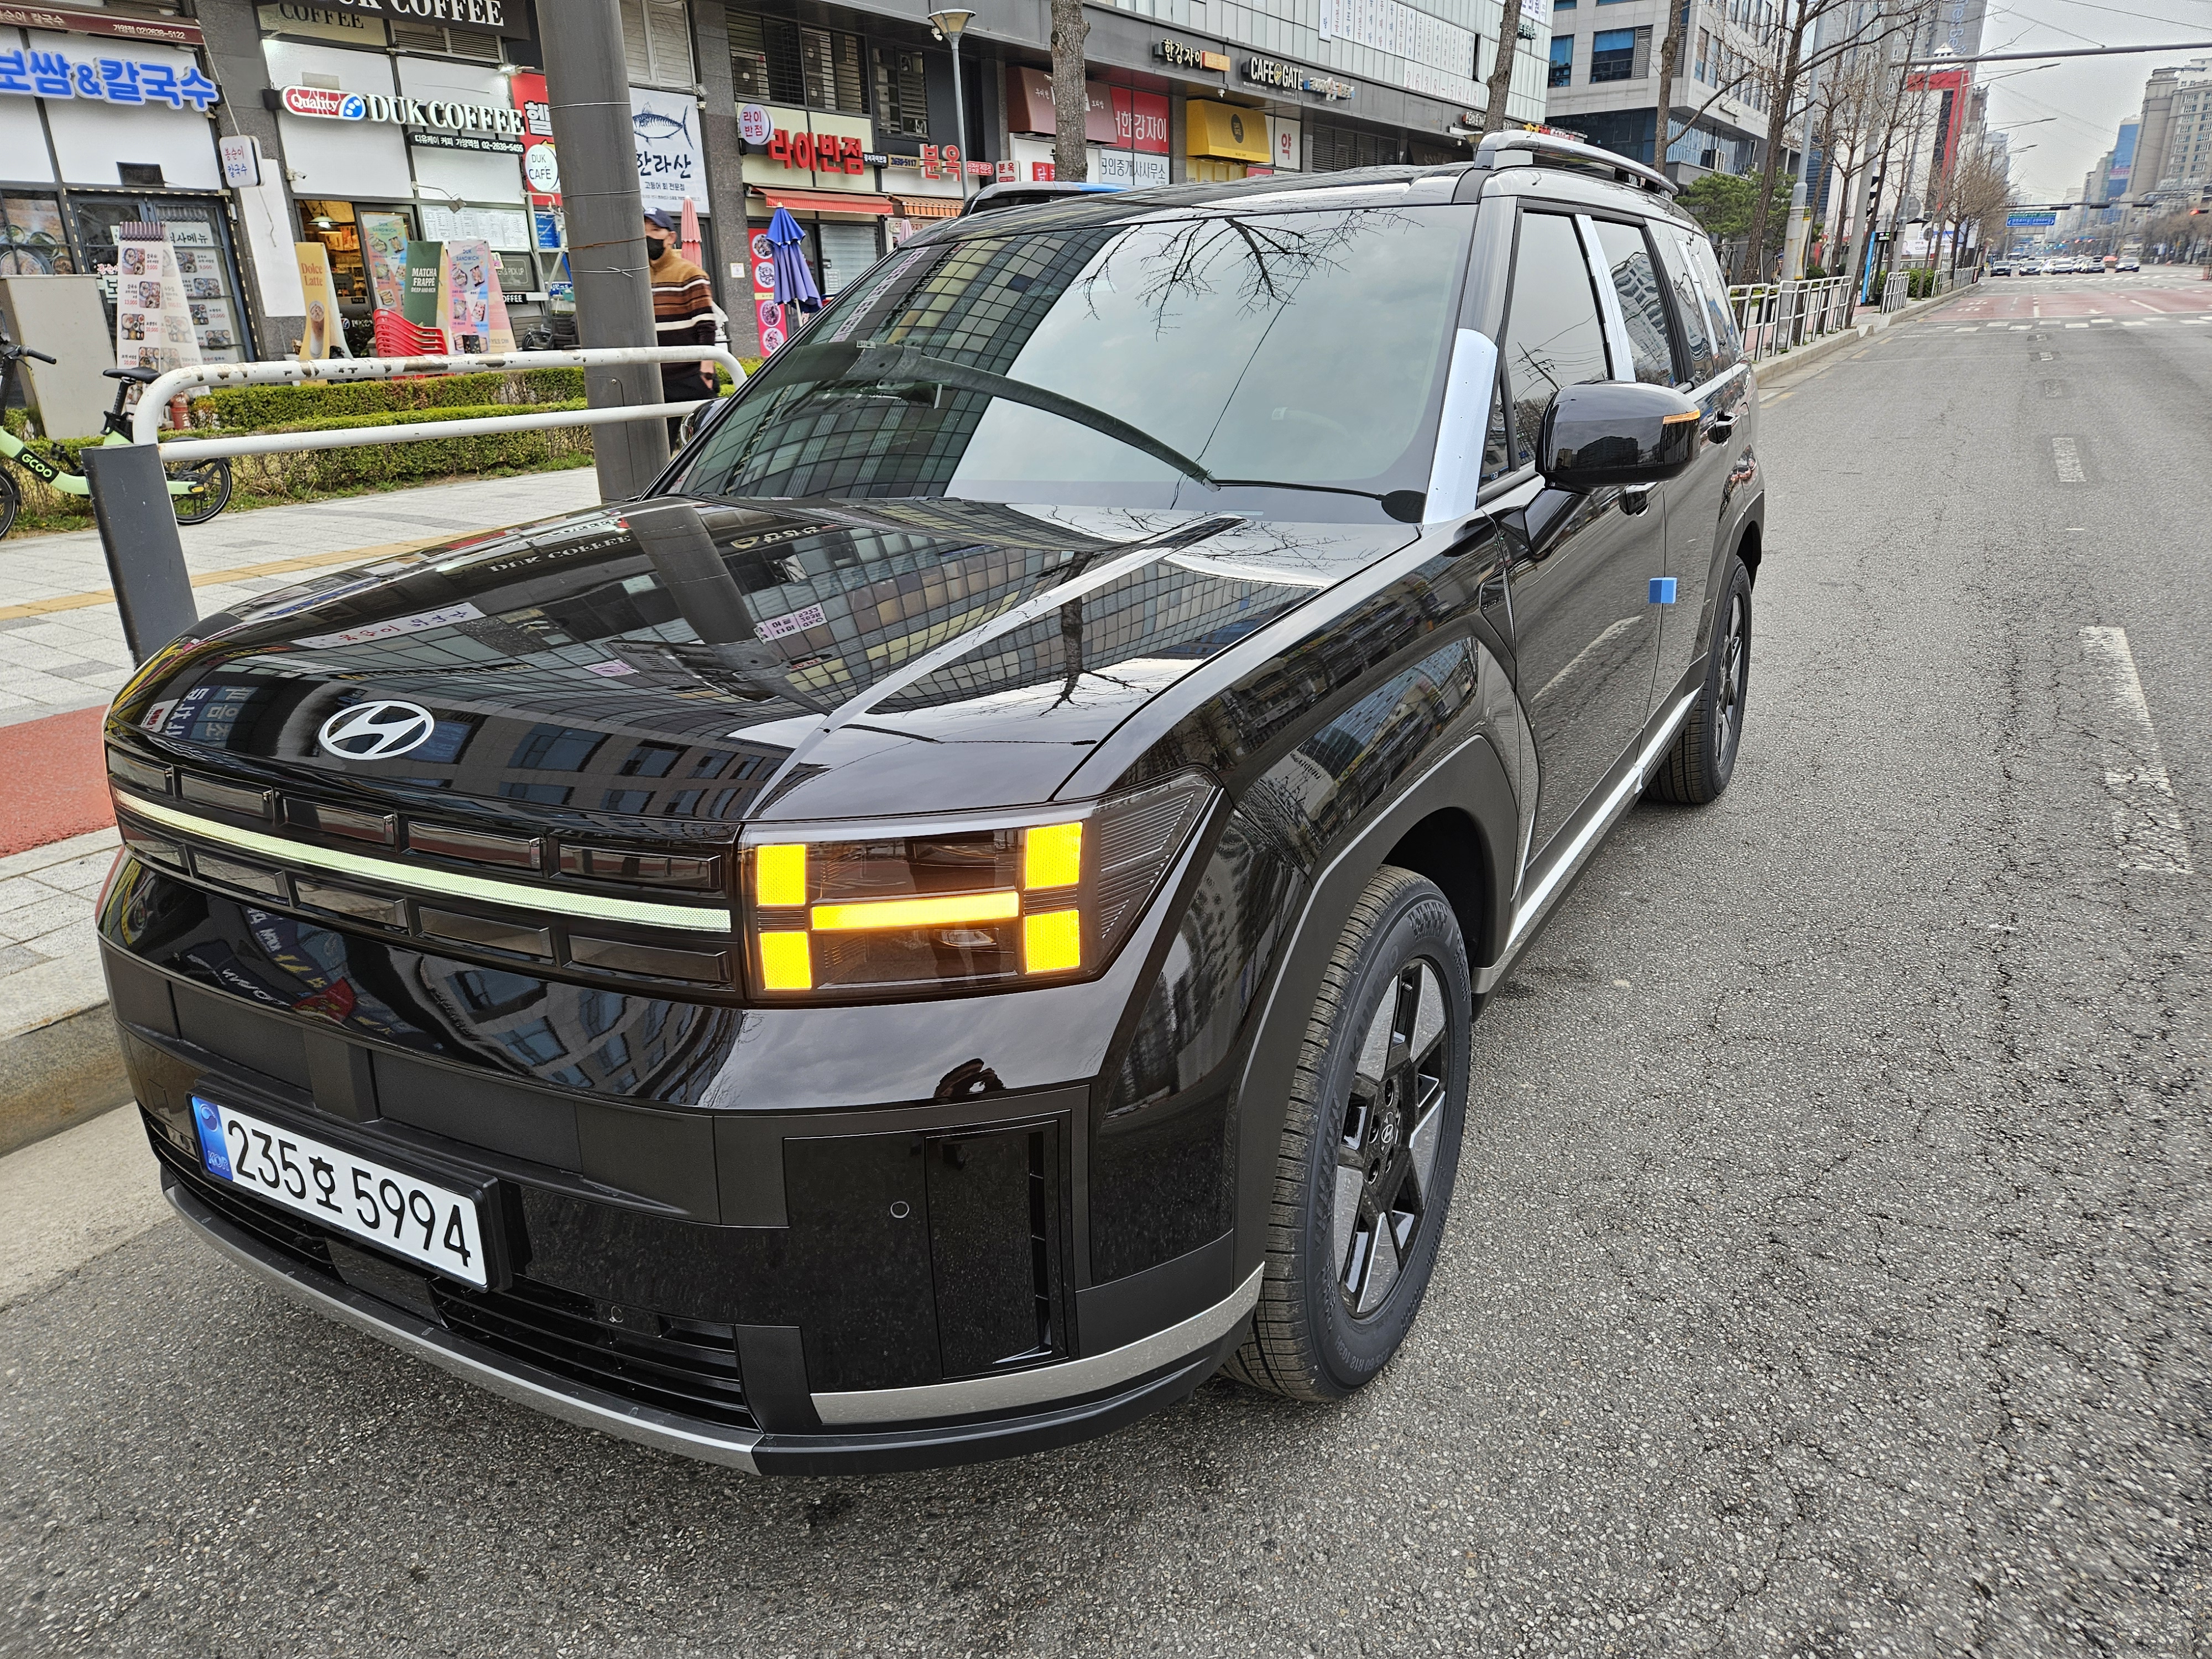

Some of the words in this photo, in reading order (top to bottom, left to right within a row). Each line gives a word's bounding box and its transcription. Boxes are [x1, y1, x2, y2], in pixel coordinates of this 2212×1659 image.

[0, 11, 27, 23] 순이
[389, 0, 504, 26] COFFEE
[1163, 38, 1202, 69] 한강자이
[0, 49, 216, 109] 보쌈&칼국수
[1250, 56, 1274, 84] CAFE
[1282, 65, 1304, 91] GATE
[291, 93, 338, 112] Quality
[364, 93, 430, 127] DUK
[426, 100, 525, 135] COFFEE
[743, 111, 762, 123] 라이
[744, 125, 763, 137] 반점
[225, 145, 244, 161] 봉순이
[531, 154, 546, 164] DUK
[768, 128, 864, 176] 라이반점
[227, 163, 248, 178] 칼국수
[637, 151, 692, 179] 한라산
[645, 181, 661, 190] 고등어
[301, 263, 323, 274] Dolce
[411, 268, 437, 276] MATCHA
[304, 275, 323, 286] Latte
[503, 294, 523, 303] OFFEE
[22, 453, 53, 478] GCOO
[206, 1150, 230, 1173] KOR
[227, 1119, 343, 1214] 235호
[351, 1166, 472, 1269] 5994
[1349, 1355, 1365, 1373] R18
